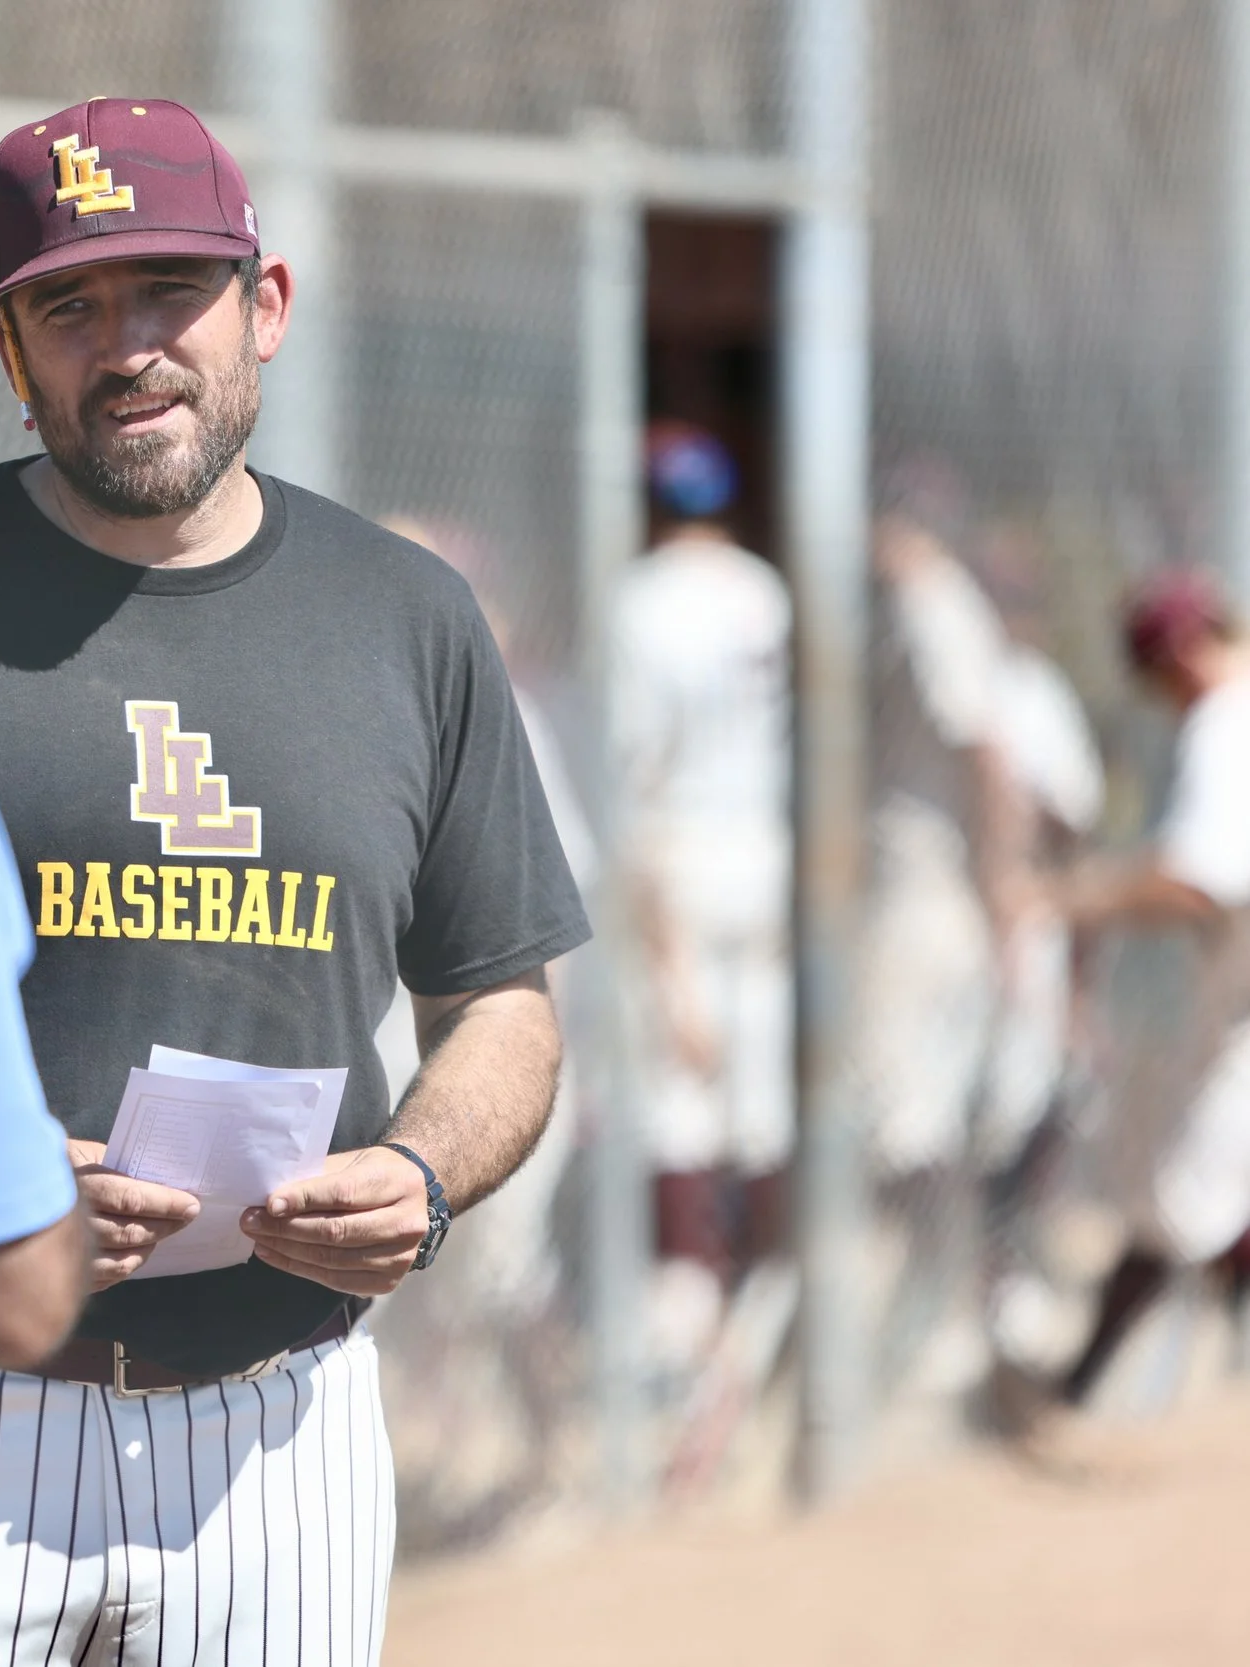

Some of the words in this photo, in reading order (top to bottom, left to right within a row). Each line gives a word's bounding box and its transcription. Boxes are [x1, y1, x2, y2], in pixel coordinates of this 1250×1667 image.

[53, 133, 135, 219] LL
[125, 700, 262, 858] LL
[36, 861, 336, 952] BASEBALL
